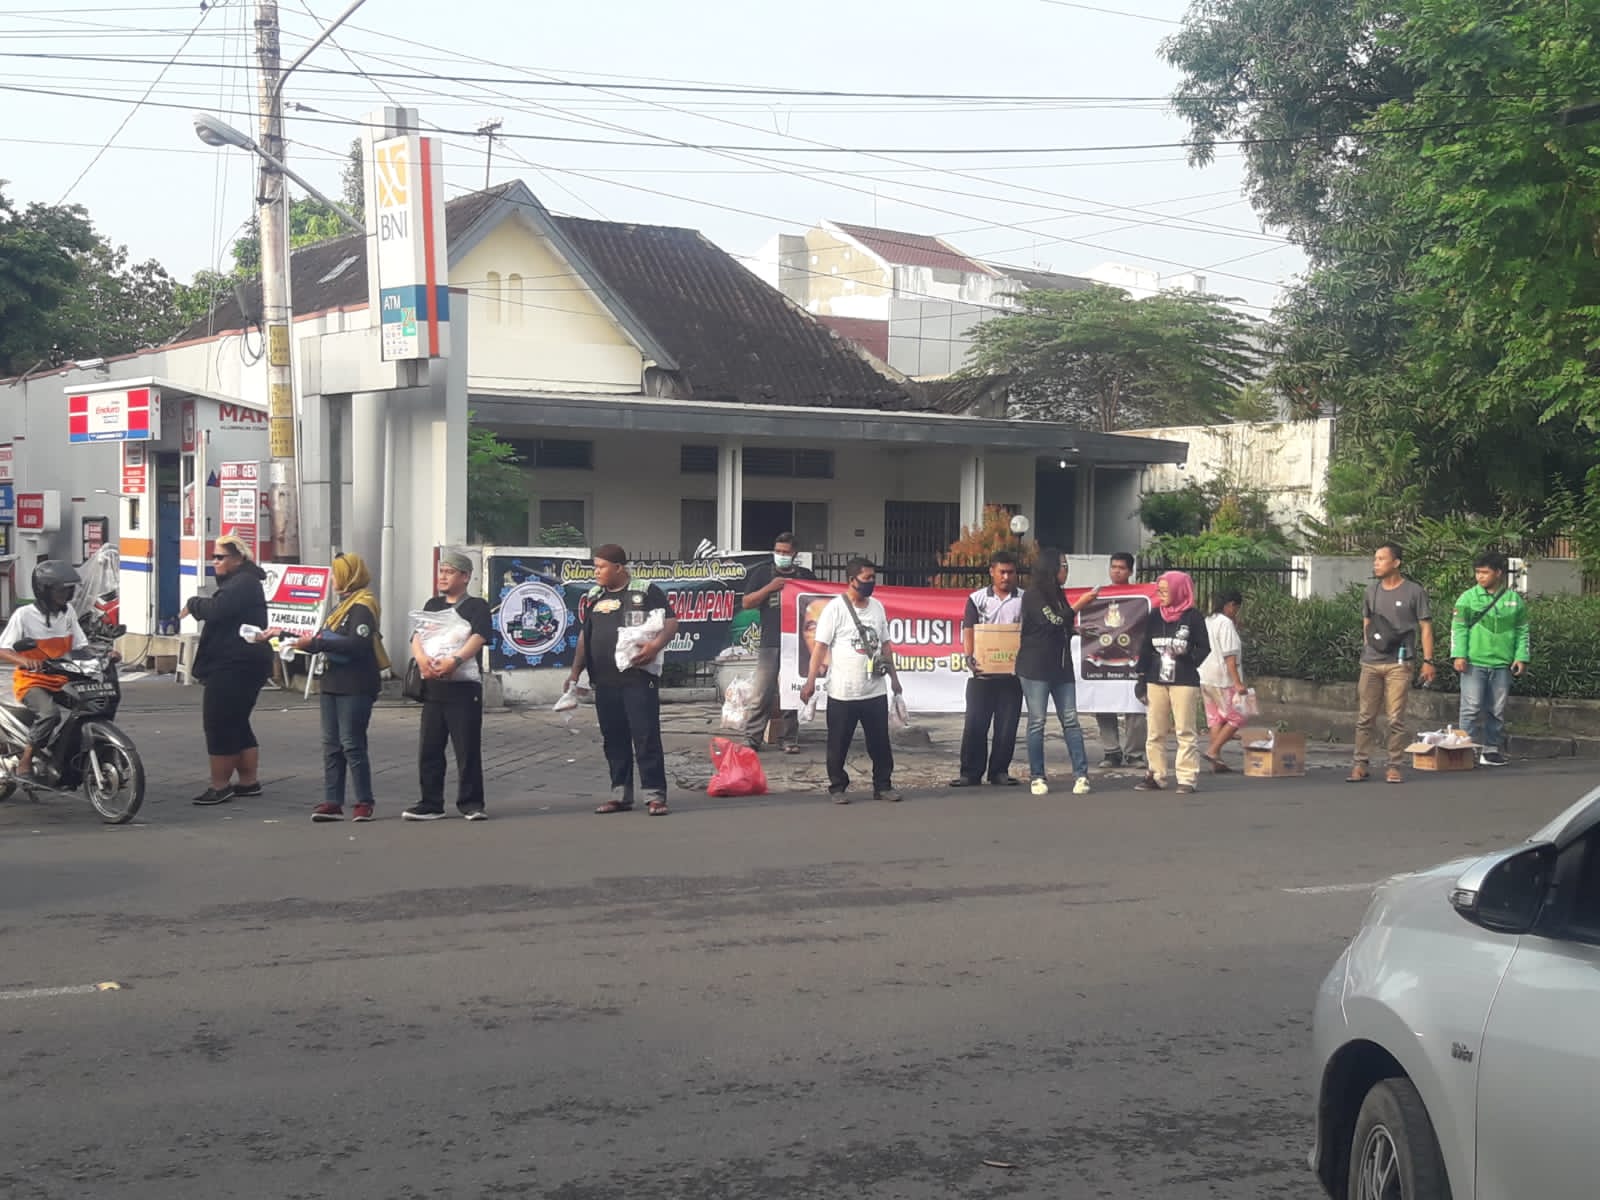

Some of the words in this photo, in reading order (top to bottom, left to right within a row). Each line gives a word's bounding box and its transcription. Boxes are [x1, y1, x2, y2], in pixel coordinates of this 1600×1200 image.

[381, 211, 407, 241] BNI
[384, 296, 400, 310] ATM
[673, 562, 710, 579] Ibadah
[711, 560, 745, 579] Puasa
[272, 613, 299, 624] TAMBAL
[301, 615, 317, 625] BAN
[891, 652, 935, 671] Lurus
